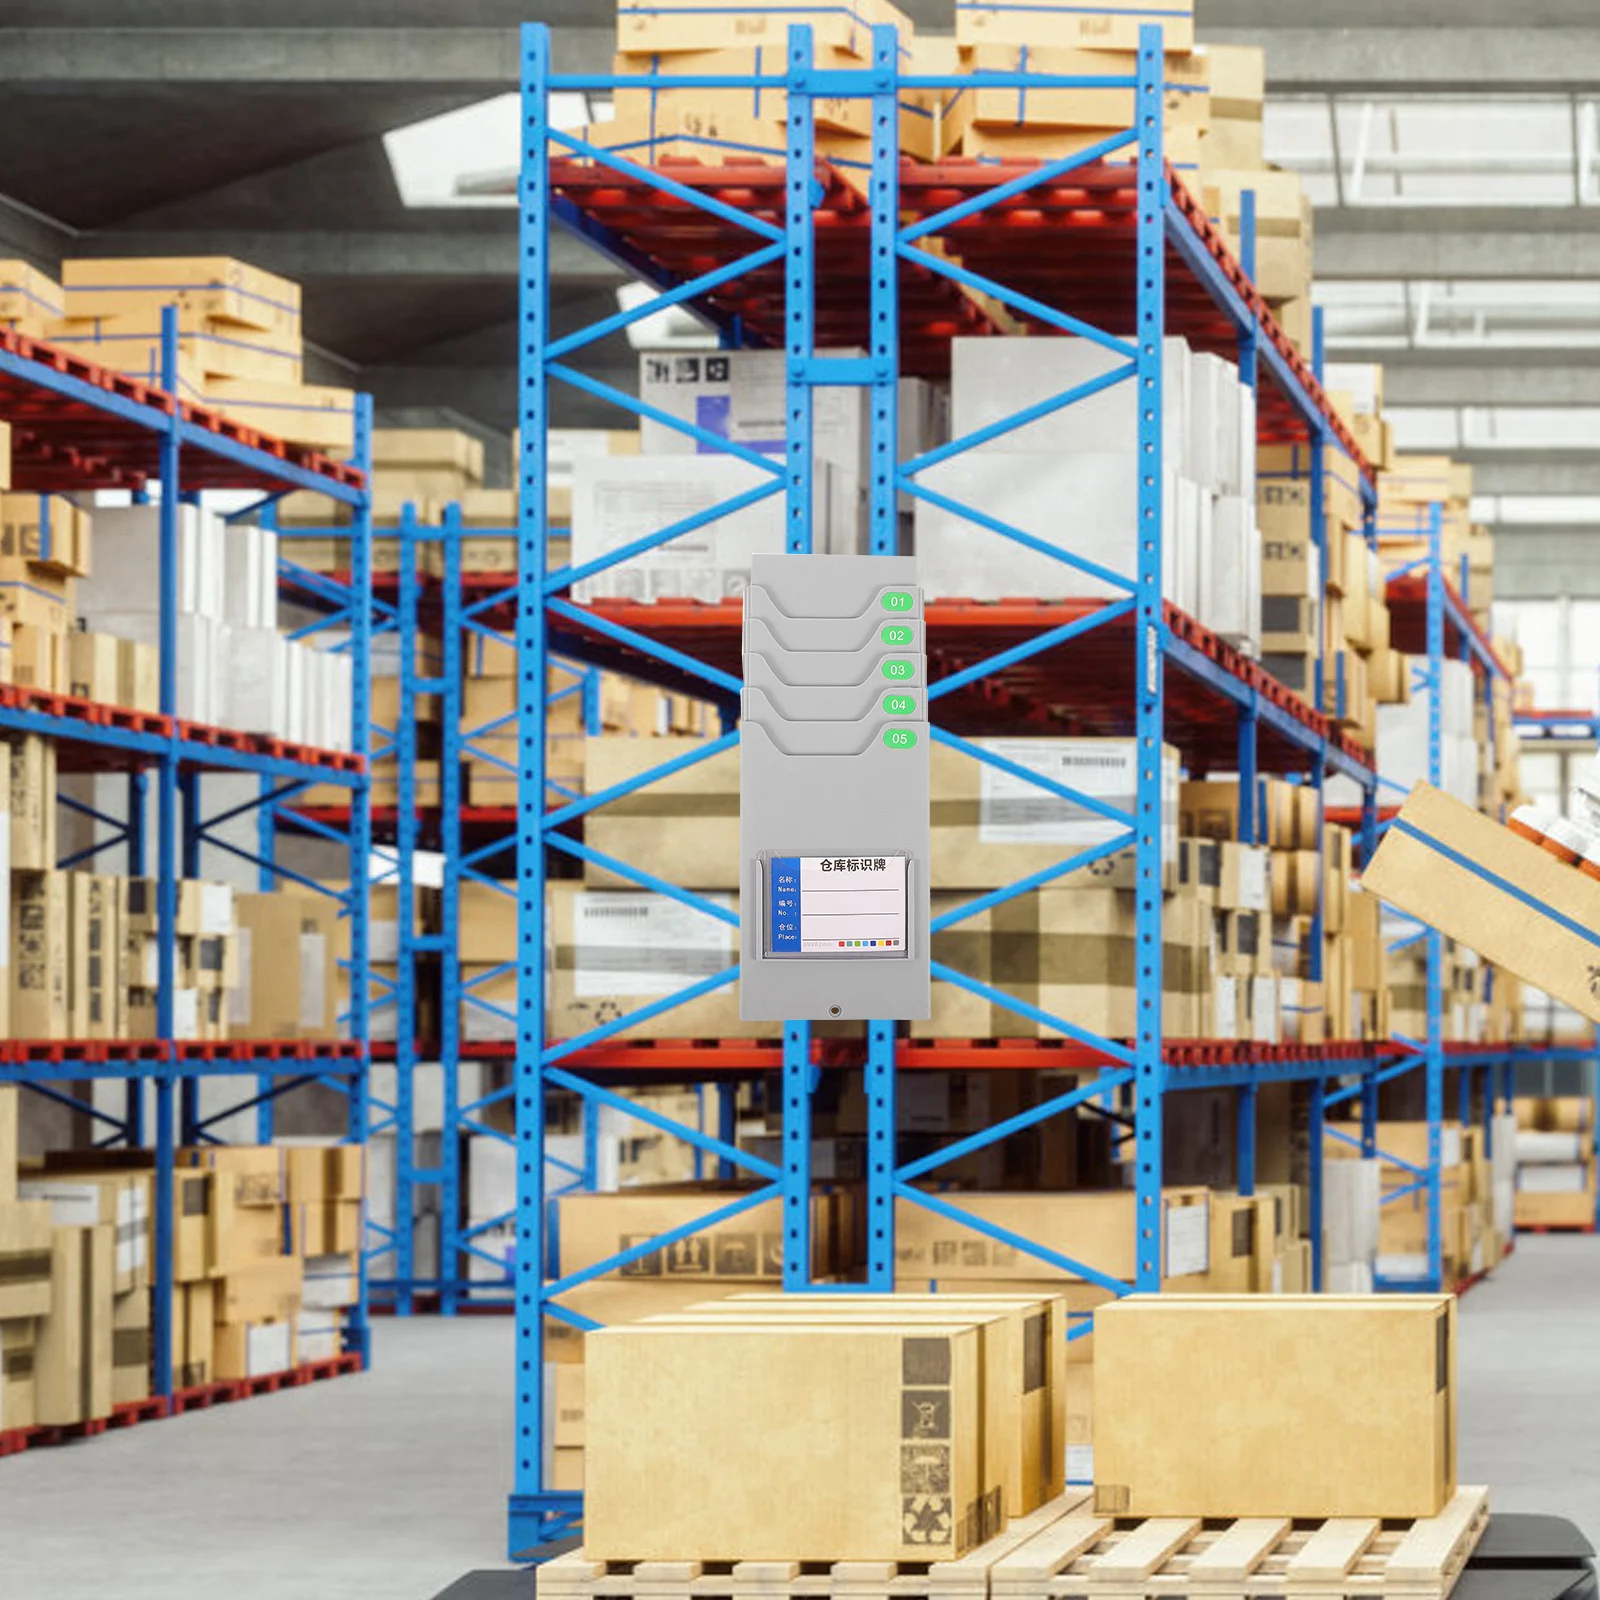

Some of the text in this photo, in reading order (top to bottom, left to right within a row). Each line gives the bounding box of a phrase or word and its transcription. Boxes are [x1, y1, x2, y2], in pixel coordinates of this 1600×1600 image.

[890, 596, 905, 607] 01
[889, 630, 904, 641] 02
[890, 664, 905, 675] 03
[891, 699, 906, 710] 04
[892, 733, 908, 744] 05
[820, 858, 887, 872] 仓库标识牌
